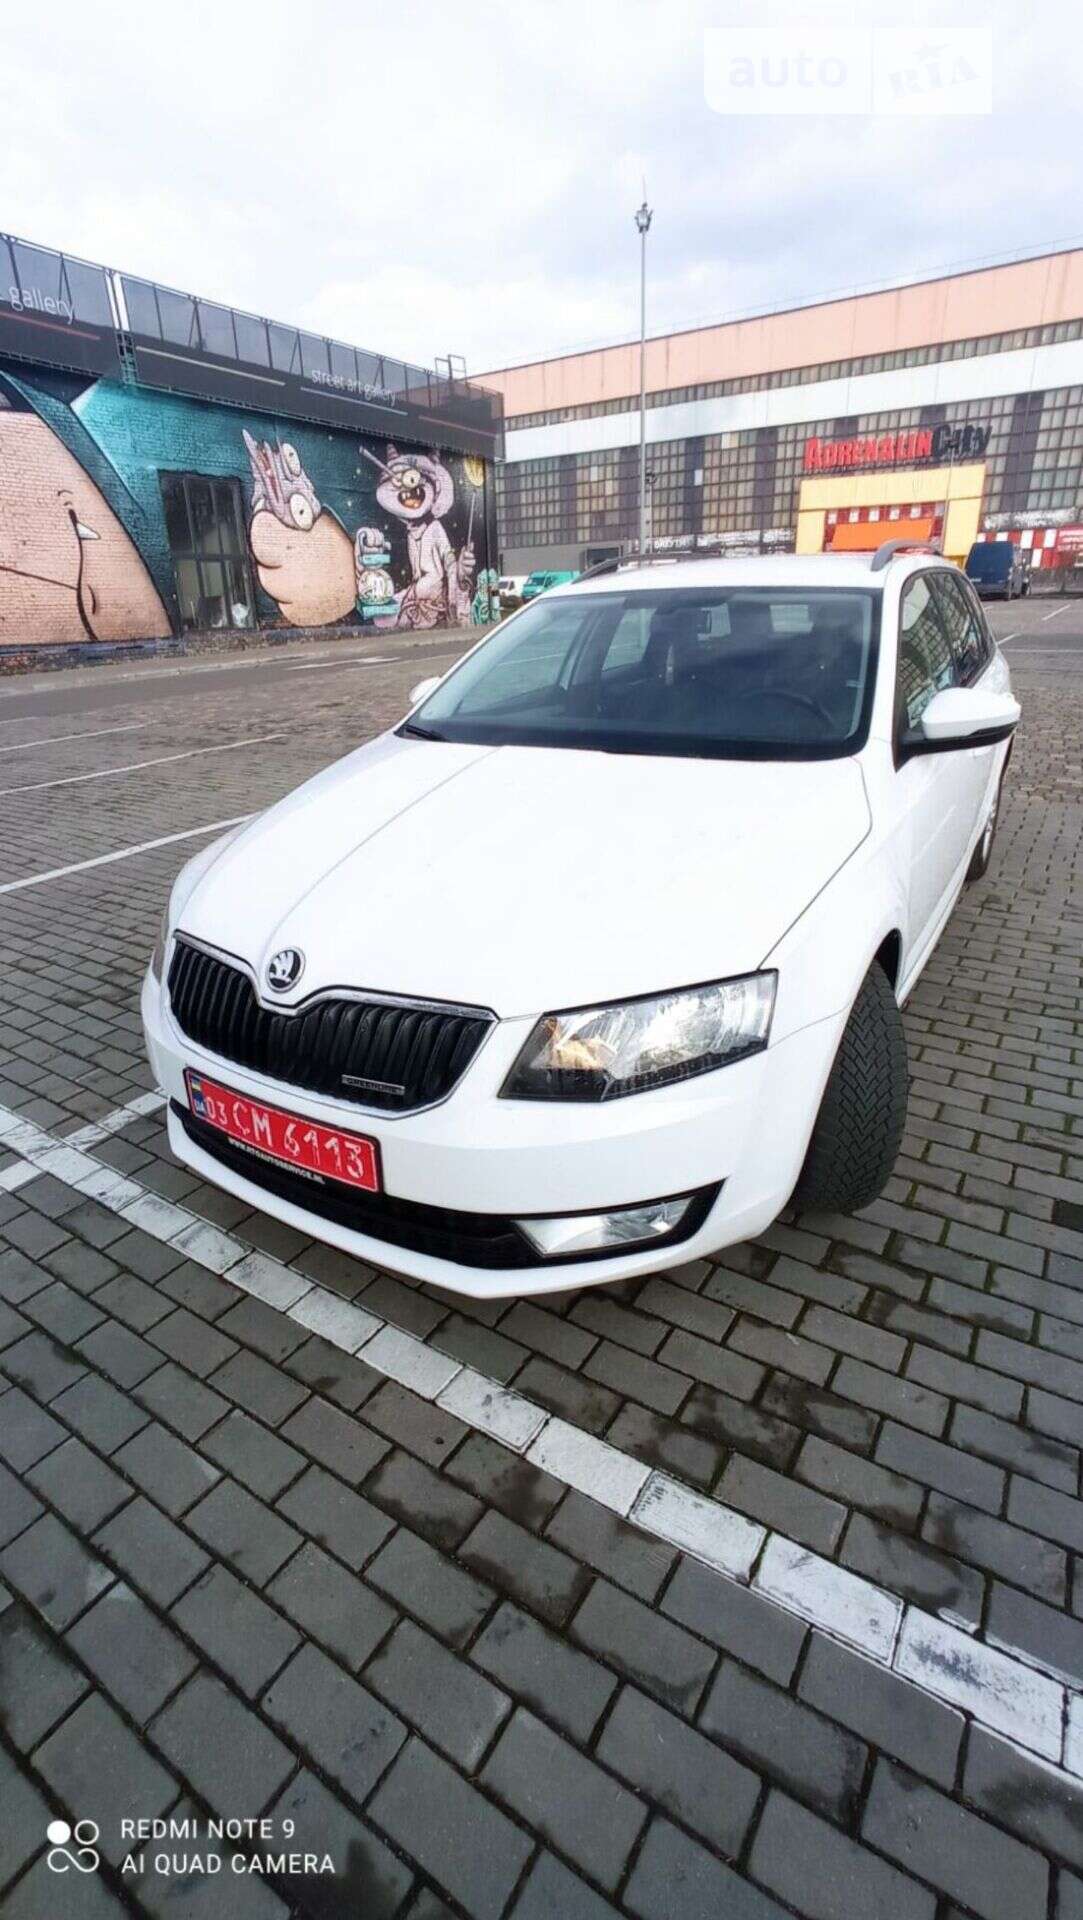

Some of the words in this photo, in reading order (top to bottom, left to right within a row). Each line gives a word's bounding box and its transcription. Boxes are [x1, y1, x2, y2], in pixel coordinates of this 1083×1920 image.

[9, 286, 74, 325] gallery
[312, 369, 343, 390] street
[364, 383, 396, 407] gallery
[206, 1096, 228, 1126] 03
[233, 1100, 273, 1148] CM
[284, 1122, 364, 1179] 6113
